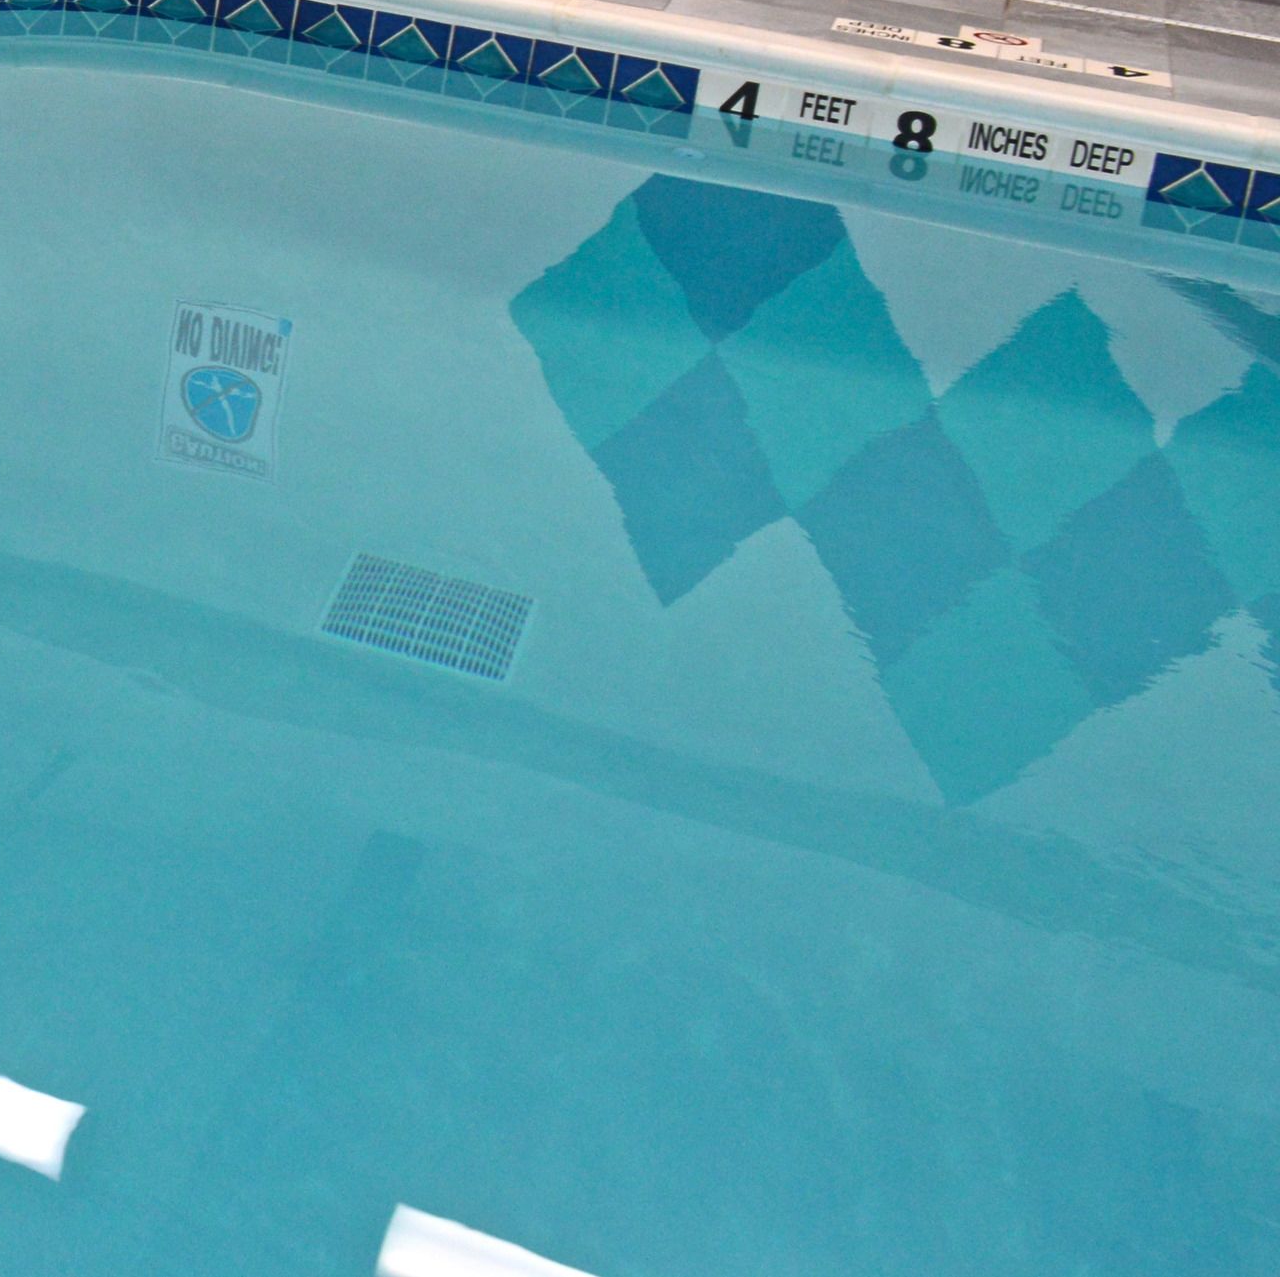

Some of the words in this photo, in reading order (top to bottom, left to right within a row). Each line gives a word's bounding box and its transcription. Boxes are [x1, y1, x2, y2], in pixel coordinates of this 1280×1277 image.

[937, 37, 977, 49] 8
[1108, 65, 1149, 78] 4
[718, 81, 761, 121] 4
[799, 91, 858, 126] FEET
[892, 110, 938, 152] 8
[968, 121, 1050, 162] INCHES
[1070, 139, 1135, 175] DEEP
